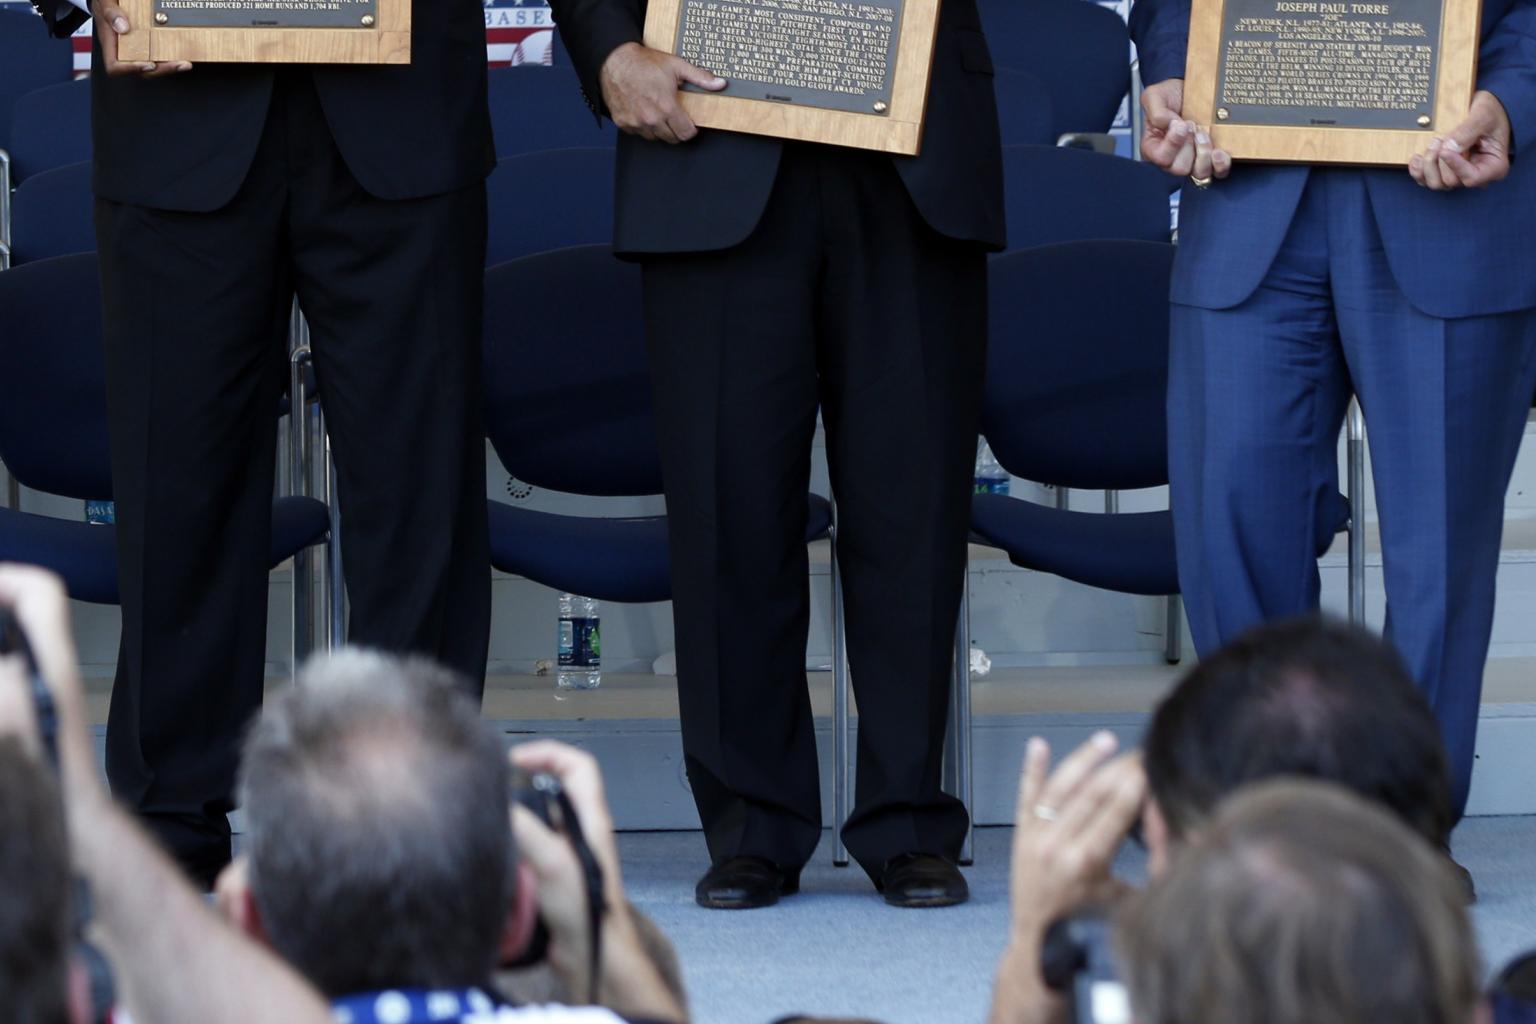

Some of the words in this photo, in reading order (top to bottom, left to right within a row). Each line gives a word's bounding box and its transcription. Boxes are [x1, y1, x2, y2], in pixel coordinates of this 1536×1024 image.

[1275, 2, 1317, 12] JOSEPH
[1320, 3, 1348, 13] PAUL
[1351, 4, 1389, 14] TORRE
